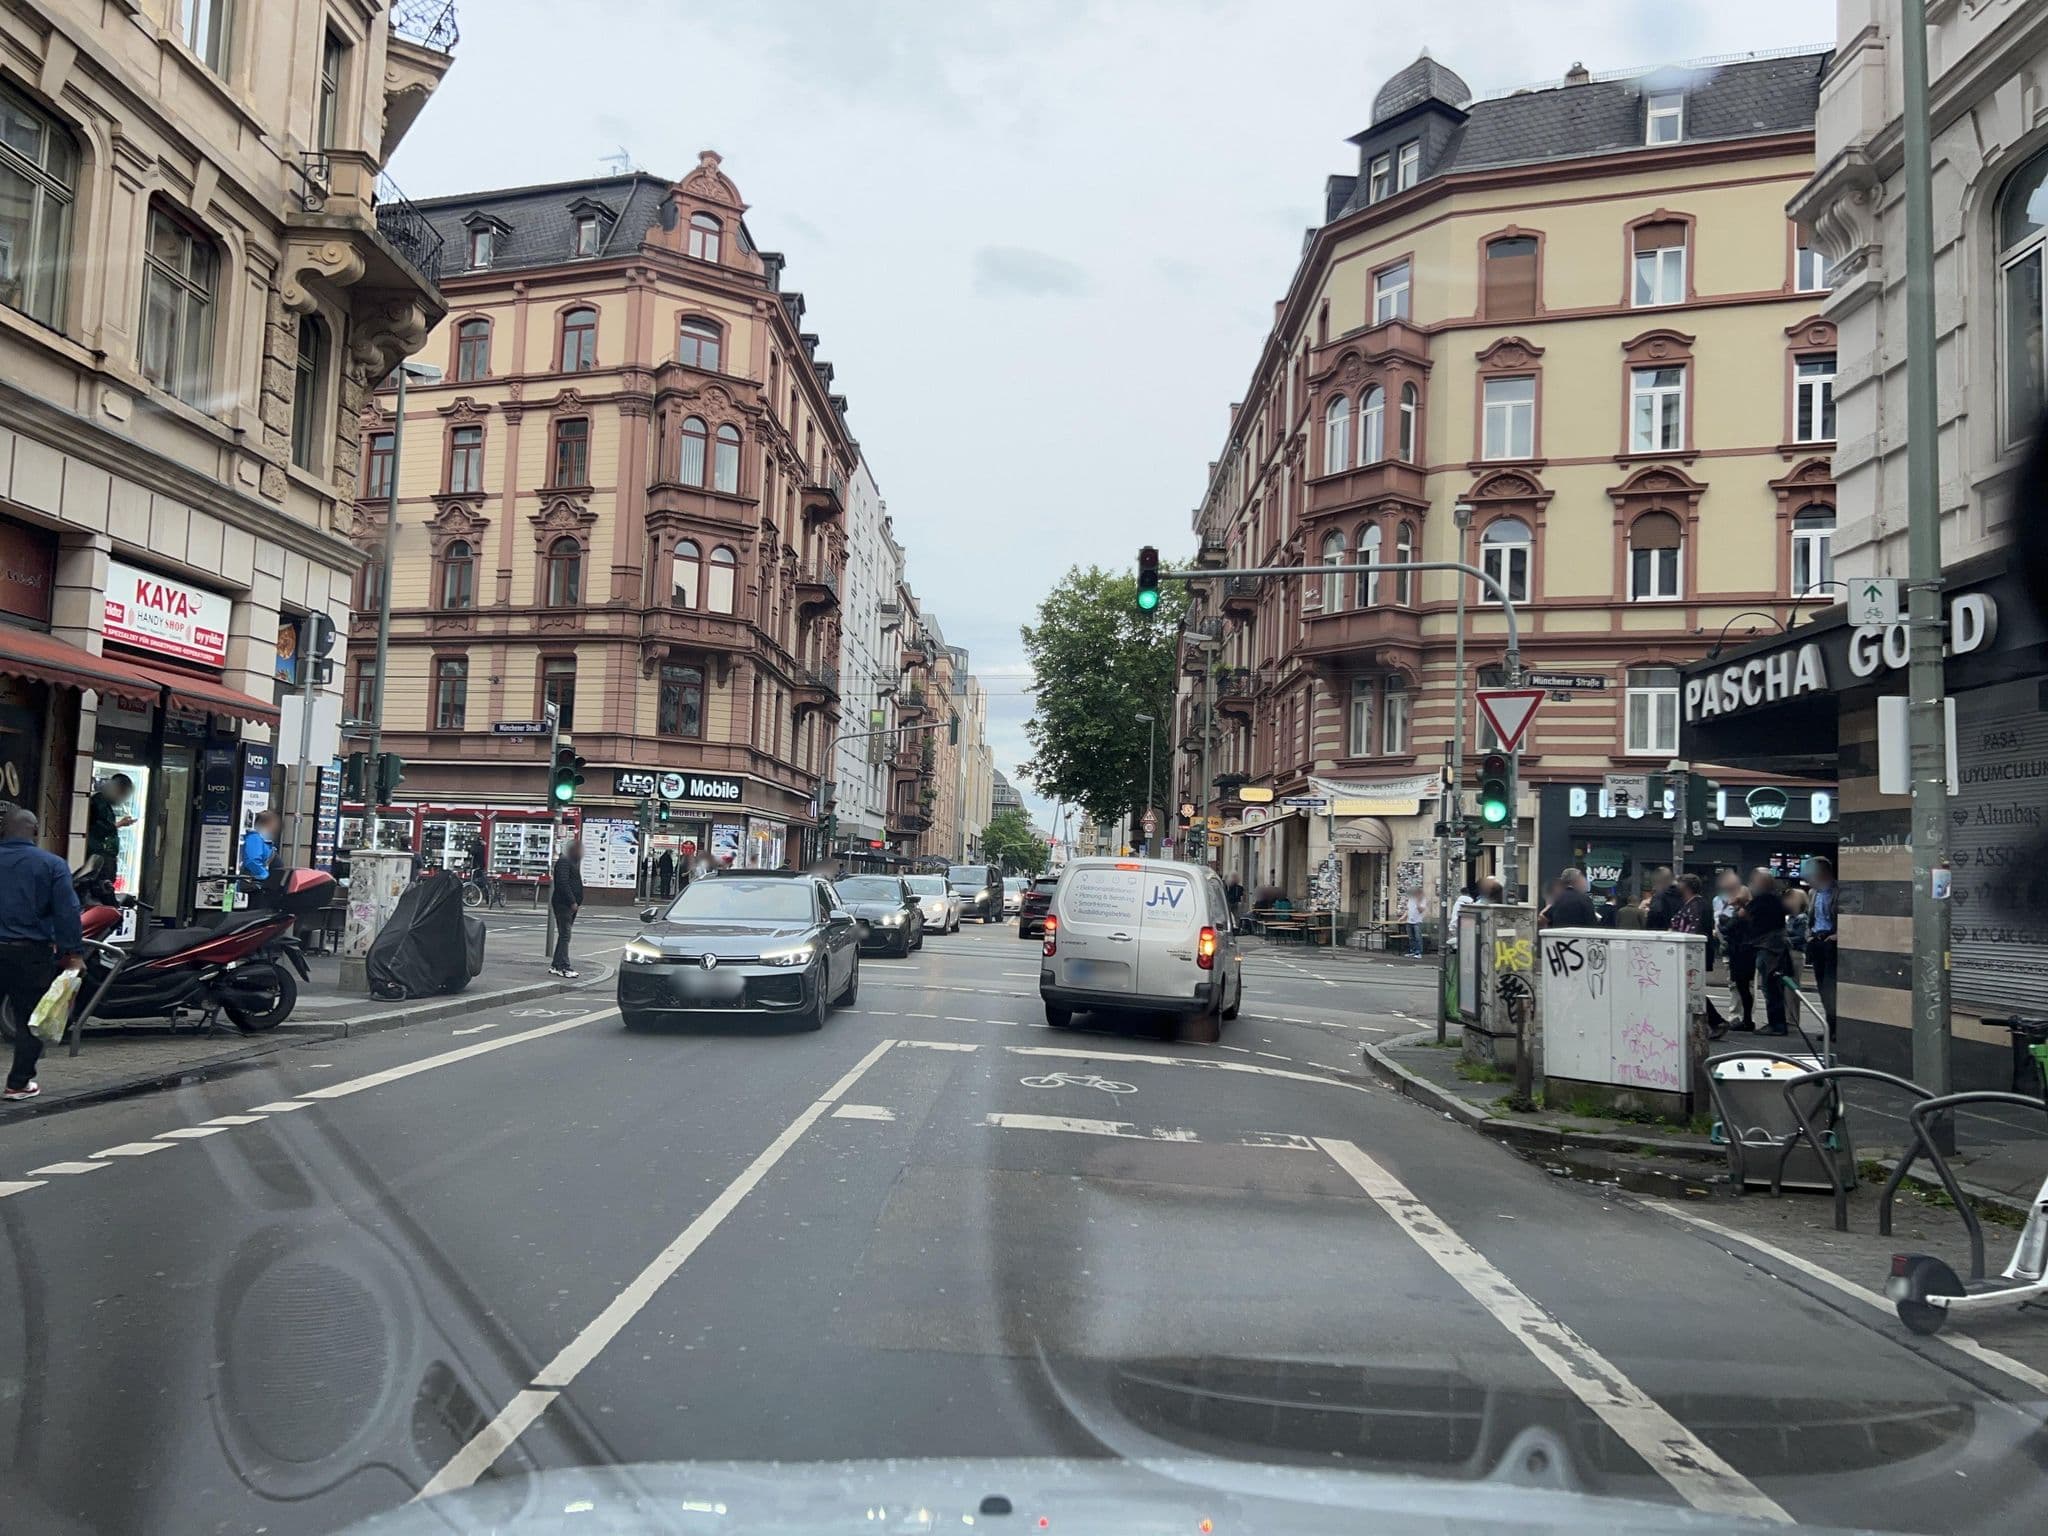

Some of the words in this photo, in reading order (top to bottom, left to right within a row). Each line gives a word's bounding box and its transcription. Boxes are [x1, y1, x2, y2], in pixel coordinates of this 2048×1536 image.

[136, 579, 188, 618] KAYA
[137, 610, 164, 627] HANDY
[165, 619, 185, 633] SHOP
[1685, 643, 1829, 722] PASCHA
[1850, 593, 1999, 678] GOD
[1532, 675, 1574, 687] Münchener
[1575, 677, 1601, 688] Straße
[247, 752, 264, 766] Lyca
[207, 783, 226, 793] Lyca
[690, 779, 739, 799] Mobile
[1145, 885, 1185, 909] J+V
